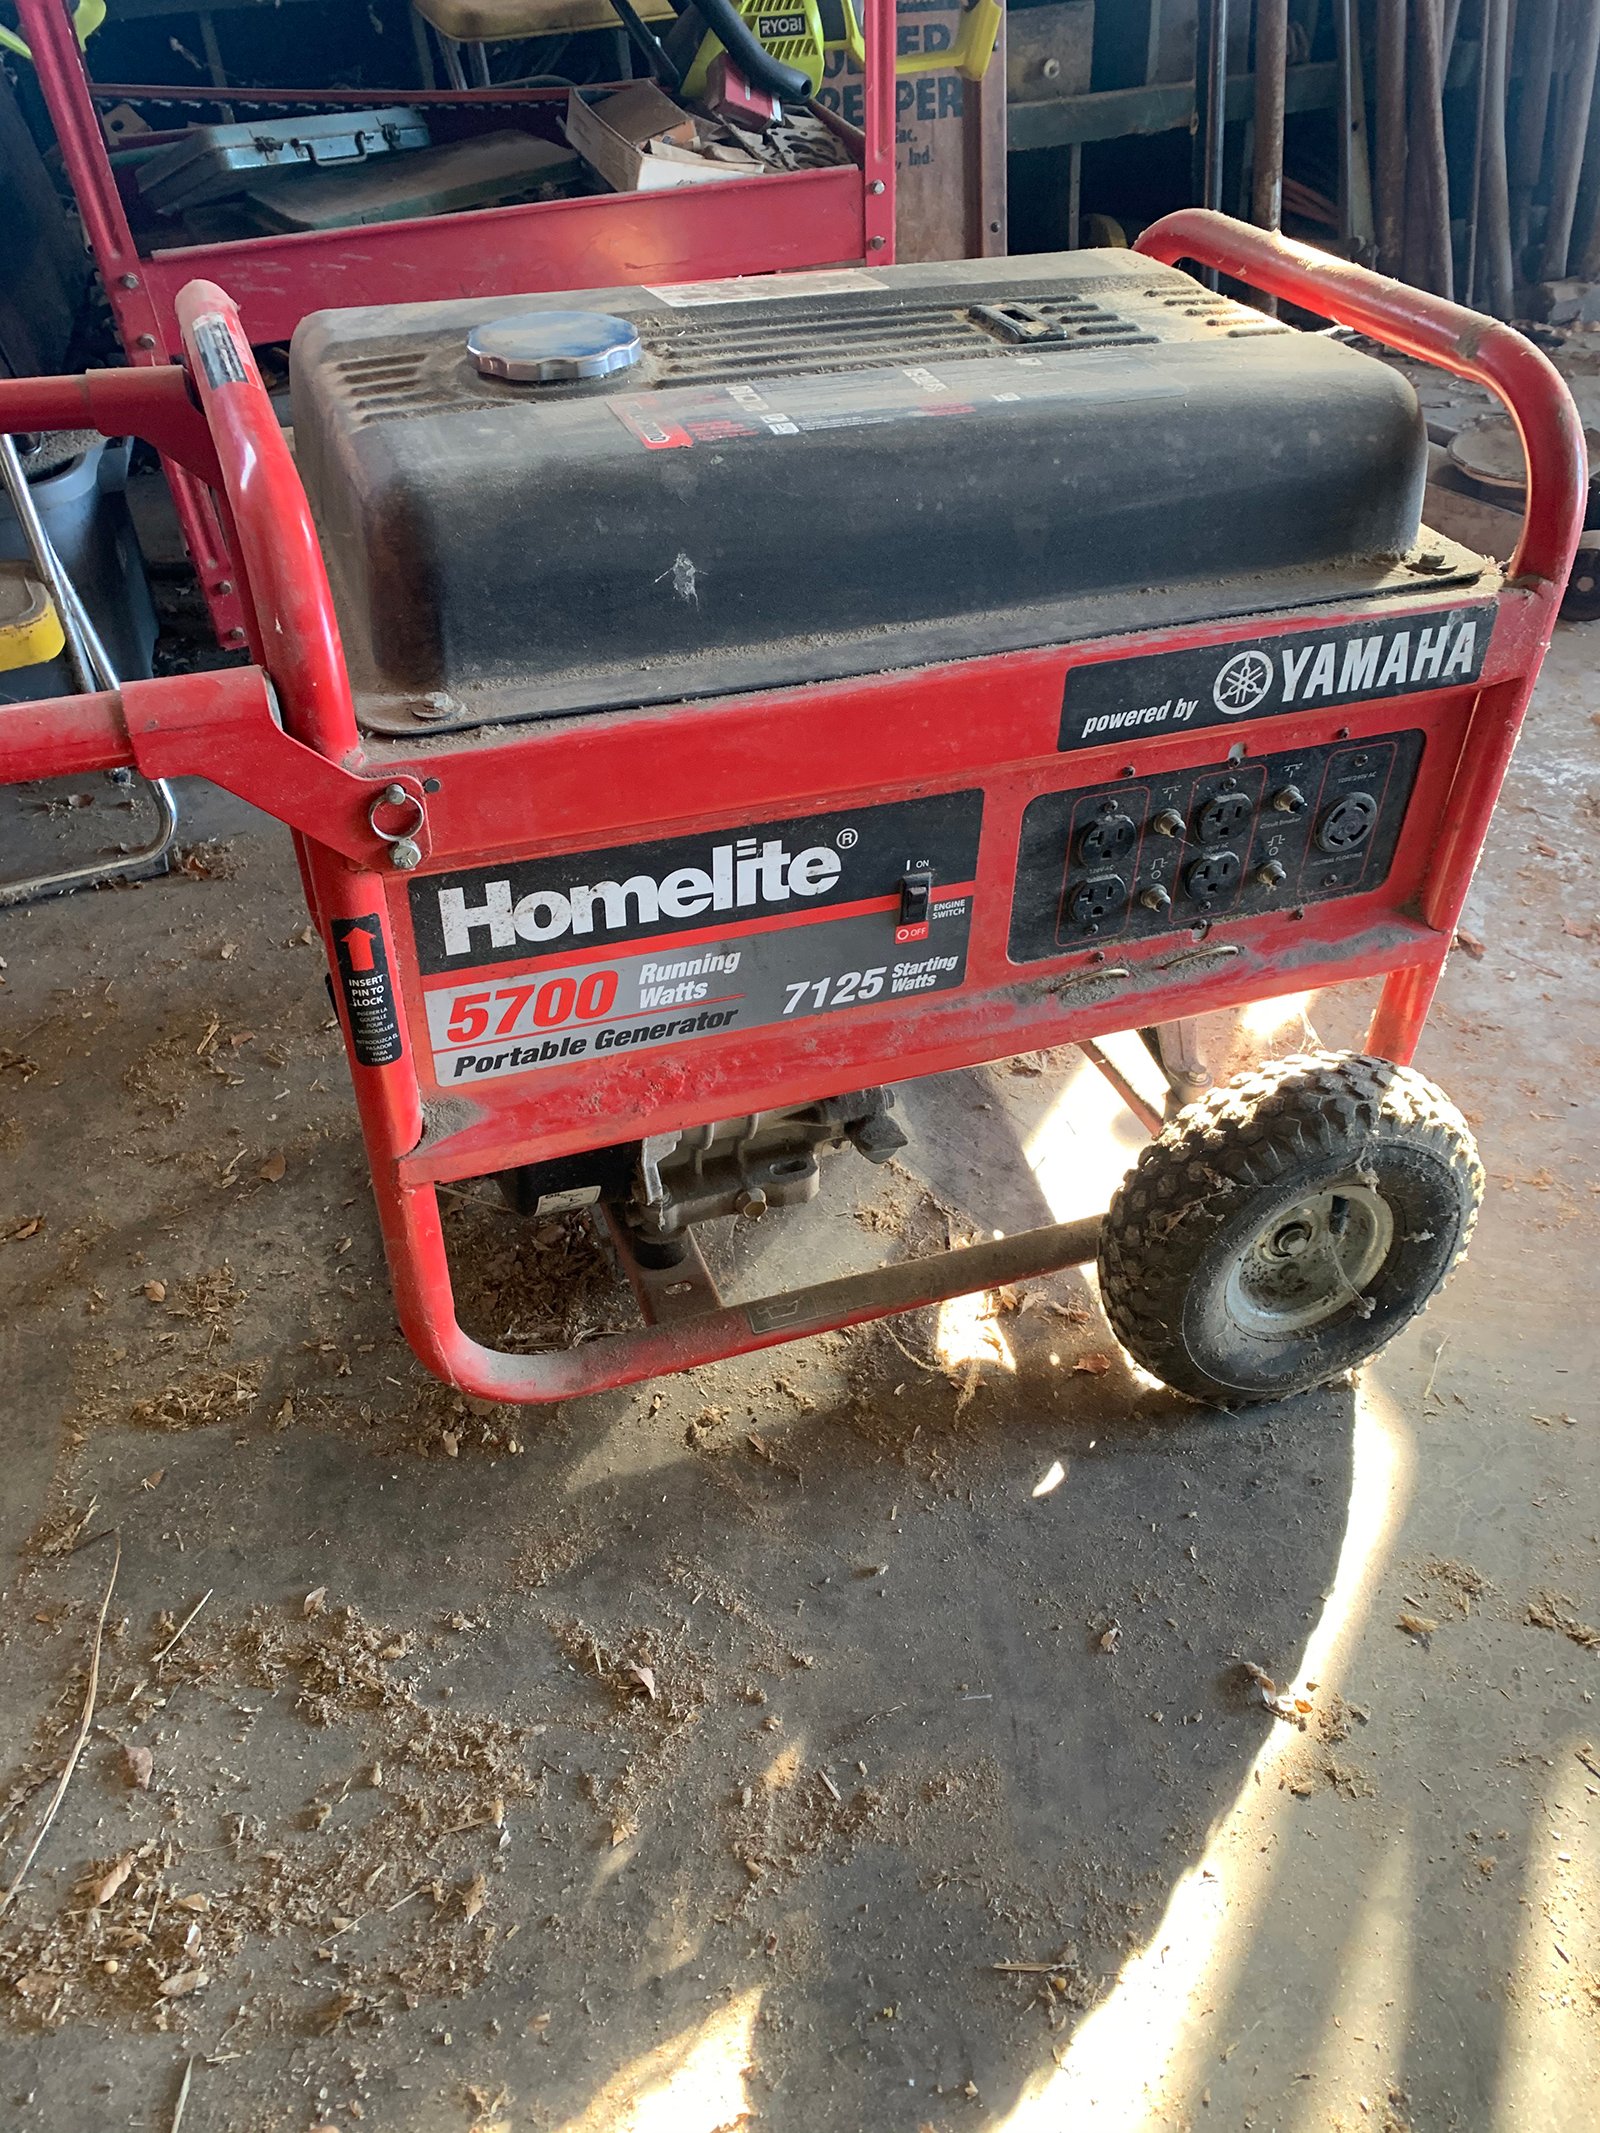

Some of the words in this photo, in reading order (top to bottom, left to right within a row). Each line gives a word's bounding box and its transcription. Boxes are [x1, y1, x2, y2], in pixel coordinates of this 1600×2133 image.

[760, 17, 802, 34] RYOBI
[1081, 698, 1171, 738] powered
[1173, 697, 1199, 723] by
[1281, 621, 1477, 703] YAMAHA
[916, 859, 929, 868] ON
[438, 838, 842, 957] Homelite
[934, 899, 965, 911] ENGINE
[932, 908, 965, 920] SWITCH
[910, 927, 926, 936] OFF
[638, 950, 741, 985] Running
[891, 955, 958, 979] Starting
[348, 974, 384, 987] INSERT
[782, 966, 887, 1015] 7125
[891, 973, 937, 993] Watts
[352, 988, 370, 997] PIN
[370, 985, 384, 995] TO
[639, 979, 709, 1009] Watts
[357, 996, 384, 1007] LOCK
[447, 970, 619, 1043] 5700
[453, 1027, 595, 1078] Portable
[595, 1009, 740, 1051] Generator
